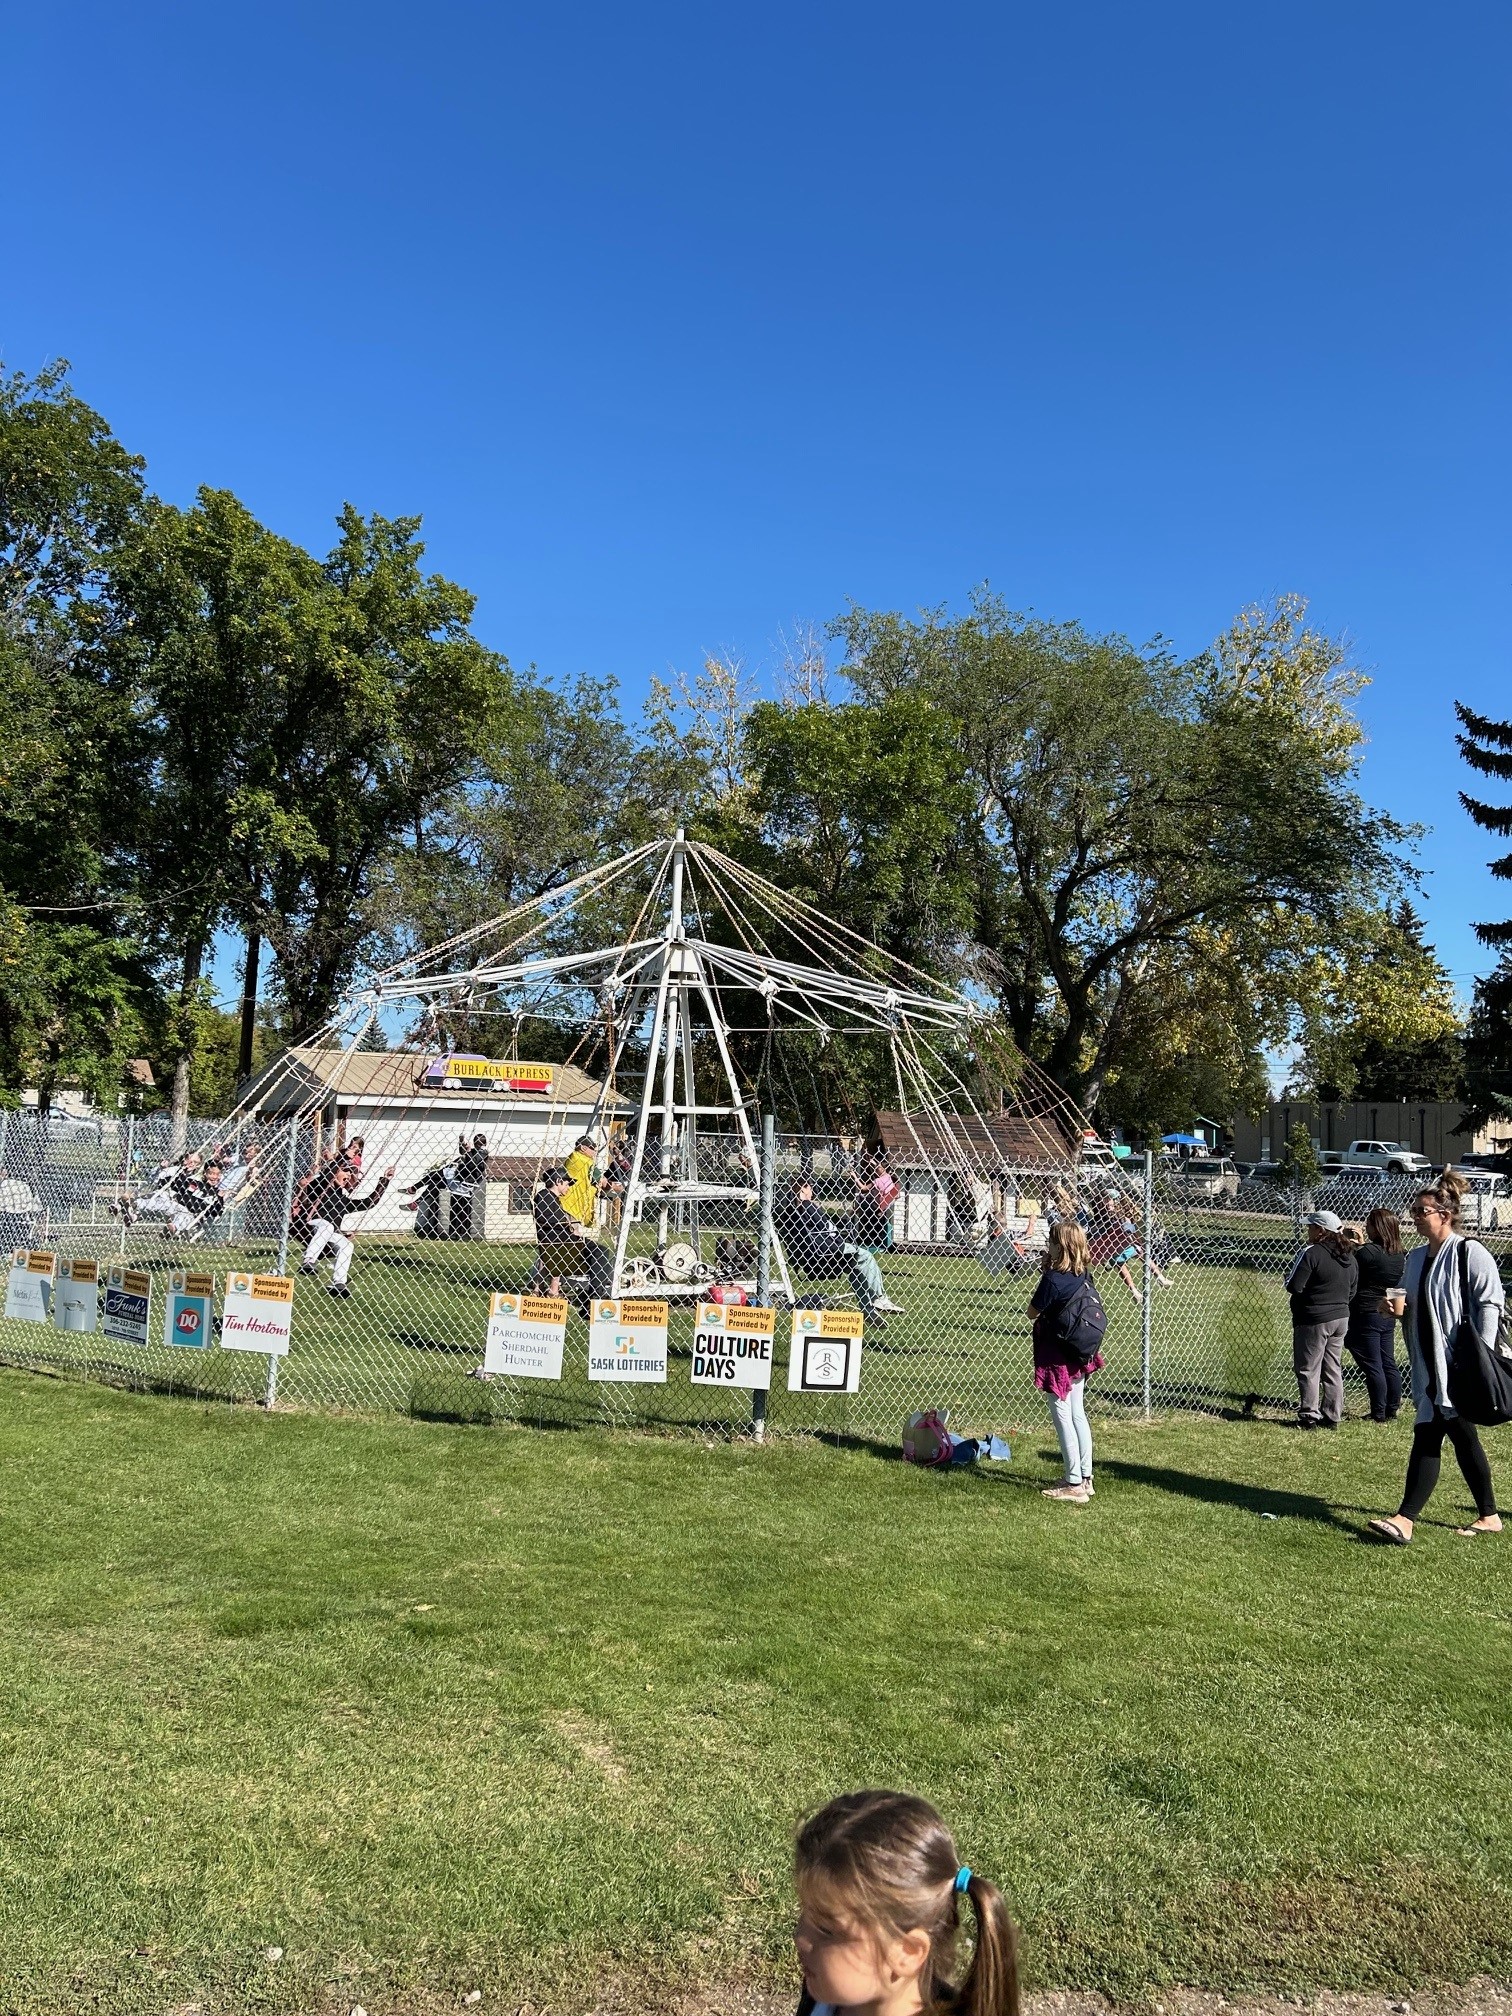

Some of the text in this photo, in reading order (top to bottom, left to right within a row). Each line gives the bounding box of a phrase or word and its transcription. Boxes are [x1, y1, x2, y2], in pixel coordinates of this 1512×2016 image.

[454, 1063, 501, 1077] BURLACK
[506, 1066, 550, 1080] EXPRESS
[186, 1276, 212, 1285] Sponsorship
[254, 1278, 290, 1289] Sponsorship
[186, 1285, 204, 1293] Provided
[254, 1288, 279, 1297] Provided
[280, 1291, 287, 1299] by
[107, 1294, 146, 1315] Funk's
[523, 1300, 564, 1311] Sponsorship
[623, 1303, 664, 1313] Sponsorship
[523, 1310, 551, 1319] Provided
[553, 1313, 562, 1321] by
[622, 1314, 652, 1323] Provided
[654, 1316, 662, 1324] by
[729, 1308, 771, 1320] Sponsorship
[823, 1315, 861, 1324] Sponsorship
[179, 1314, 198, 1329] DQ
[225, 1315, 288, 1336] Tim Hortons
[729, 1319, 758, 1329] Provided
[759, 1323, 768, 1331] by
[492, 1326, 561, 1343] PARCHOMCHUK
[823, 1325, 850, 1333] Provided
[851, 1326, 858, 1334] by
[502, 1341, 548, 1355] SHERDAHL
[696, 1334, 770, 1360] CULTURE
[505, 1354, 543, 1367] HUNTER
[824, 1353, 831, 1362] R
[591, 1358, 665, 1372] SASK LOTTERIES
[694, 1356, 736, 1380] DAYS
[823, 1367, 830, 1376] S
